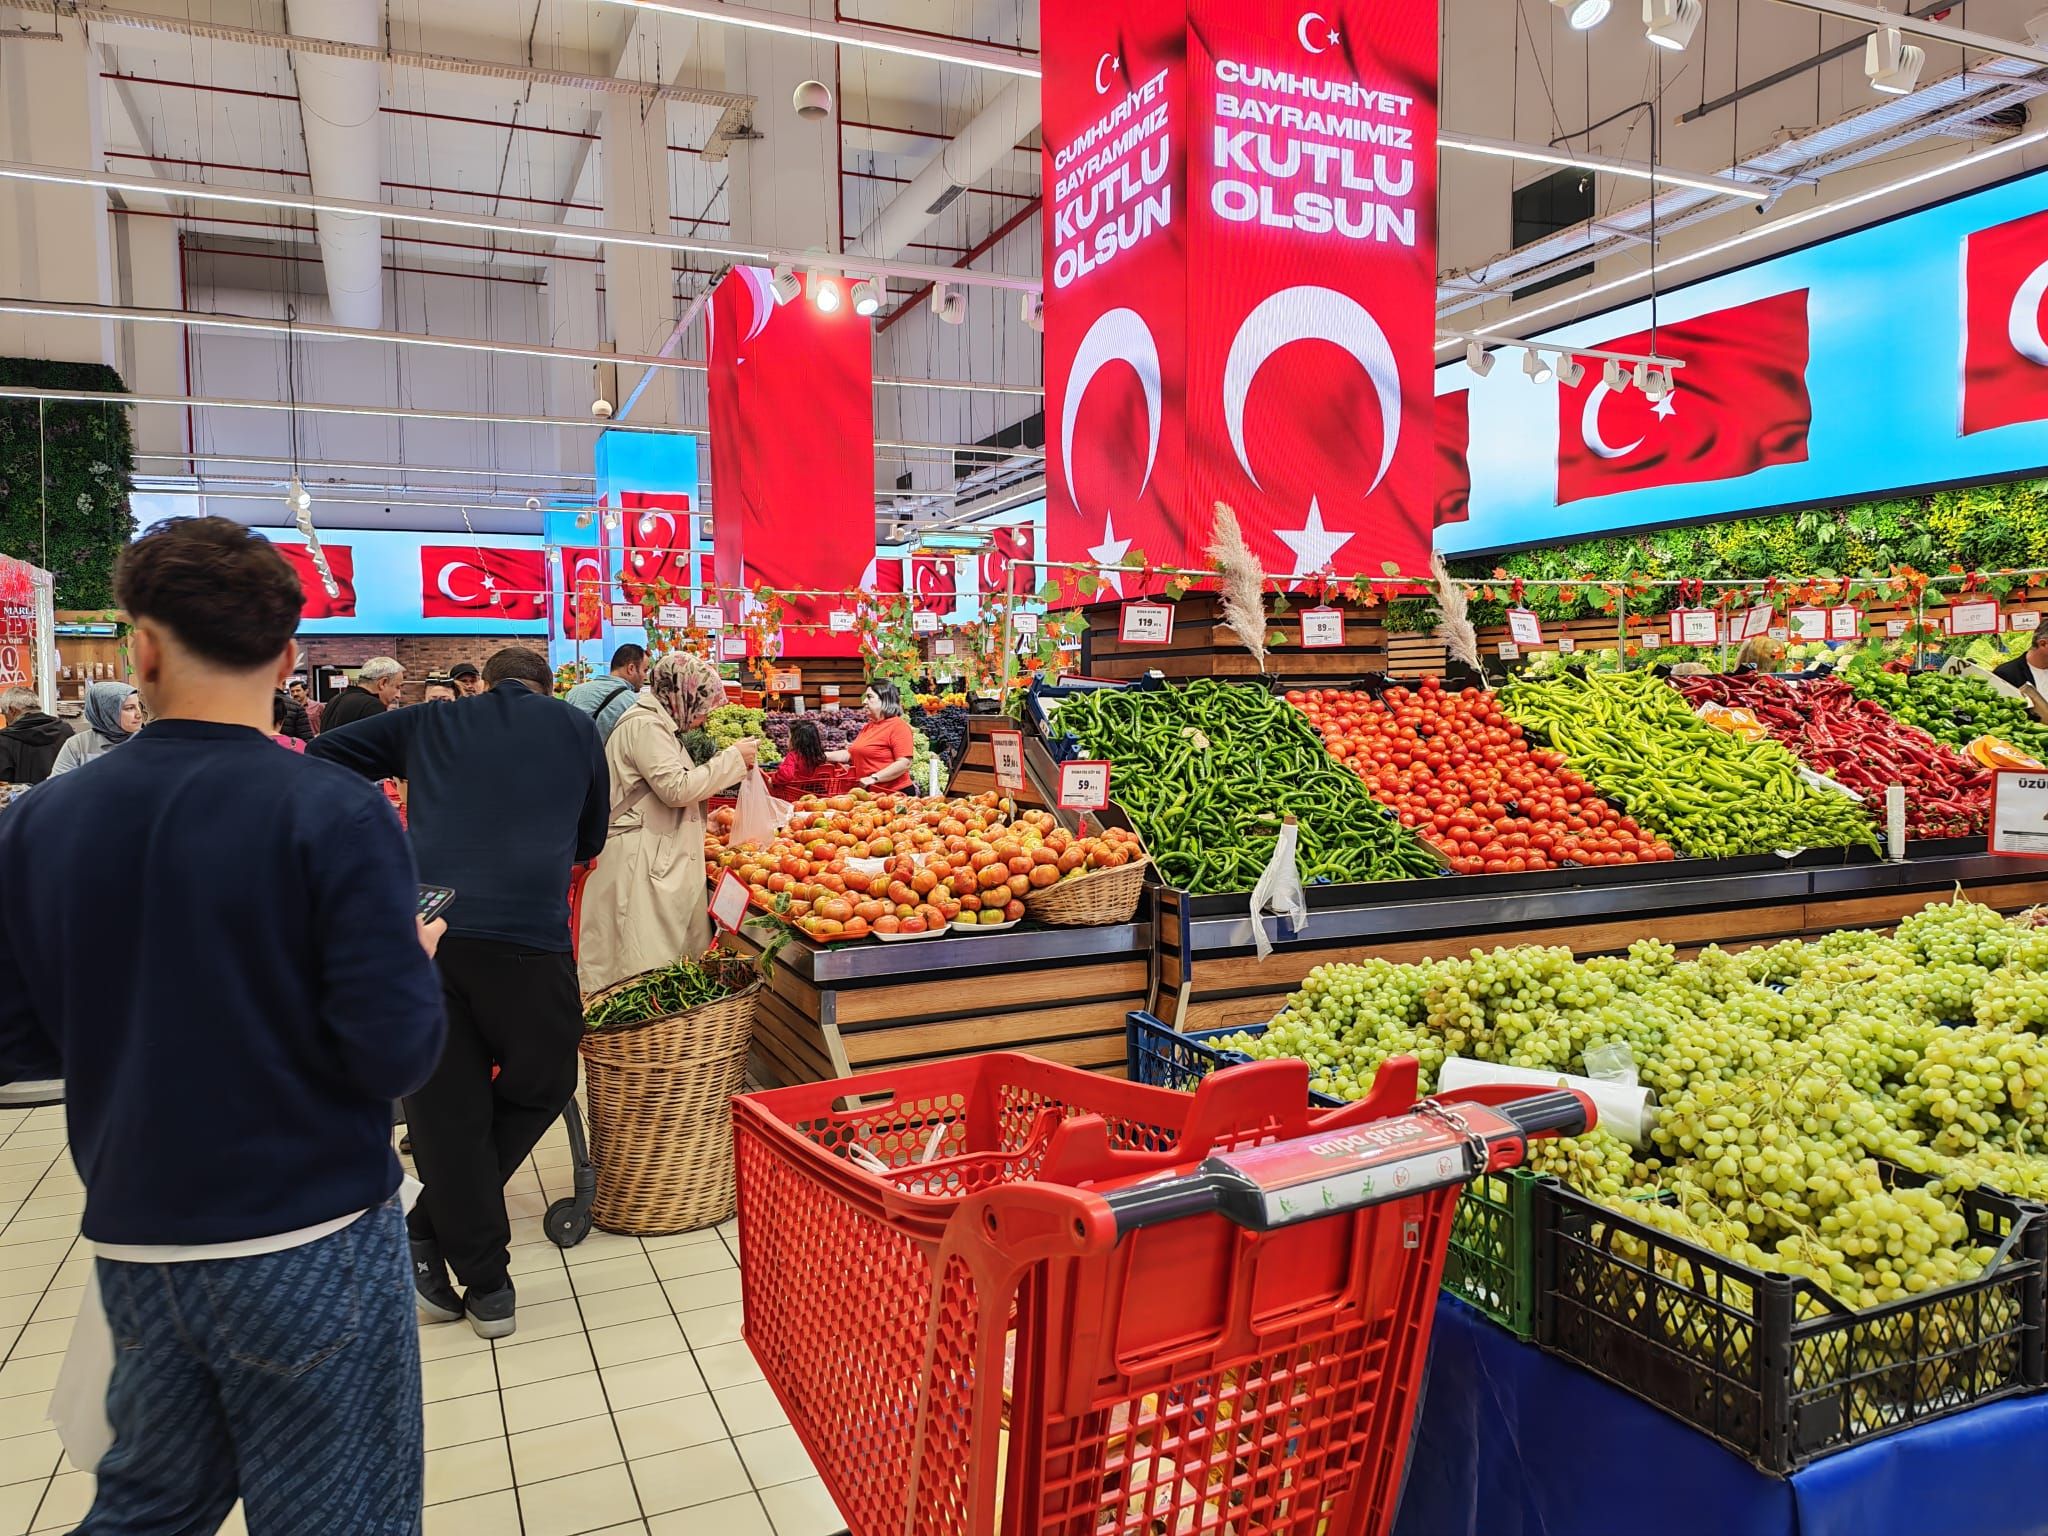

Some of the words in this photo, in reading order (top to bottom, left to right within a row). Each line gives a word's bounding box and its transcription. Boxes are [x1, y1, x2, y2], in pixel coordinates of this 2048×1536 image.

[1054, 67, 1168, 171] CUMHURİYET
[1215, 59, 1413, 117] CUMHURİYET
[1055, 101, 1168, 202] BAYRAMIMIZ
[1215, 93, 1413, 150] BAYRAMIMIZ
[1054, 133, 1170, 247] KUTLU
[1213, 126, 1414, 197] KUTLU
[1053, 184, 1171, 289] OLSUN
[1210, 179, 1416, 246] OLSUN
[1138, 618, 1152, 626] 119
[1078, 780, 1090, 790] 59
[2018, 777, 2048, 789] ÜZÜ
[1308, 1134, 1367, 1155] anpa
[1365, 1122, 1423, 1146] gross
